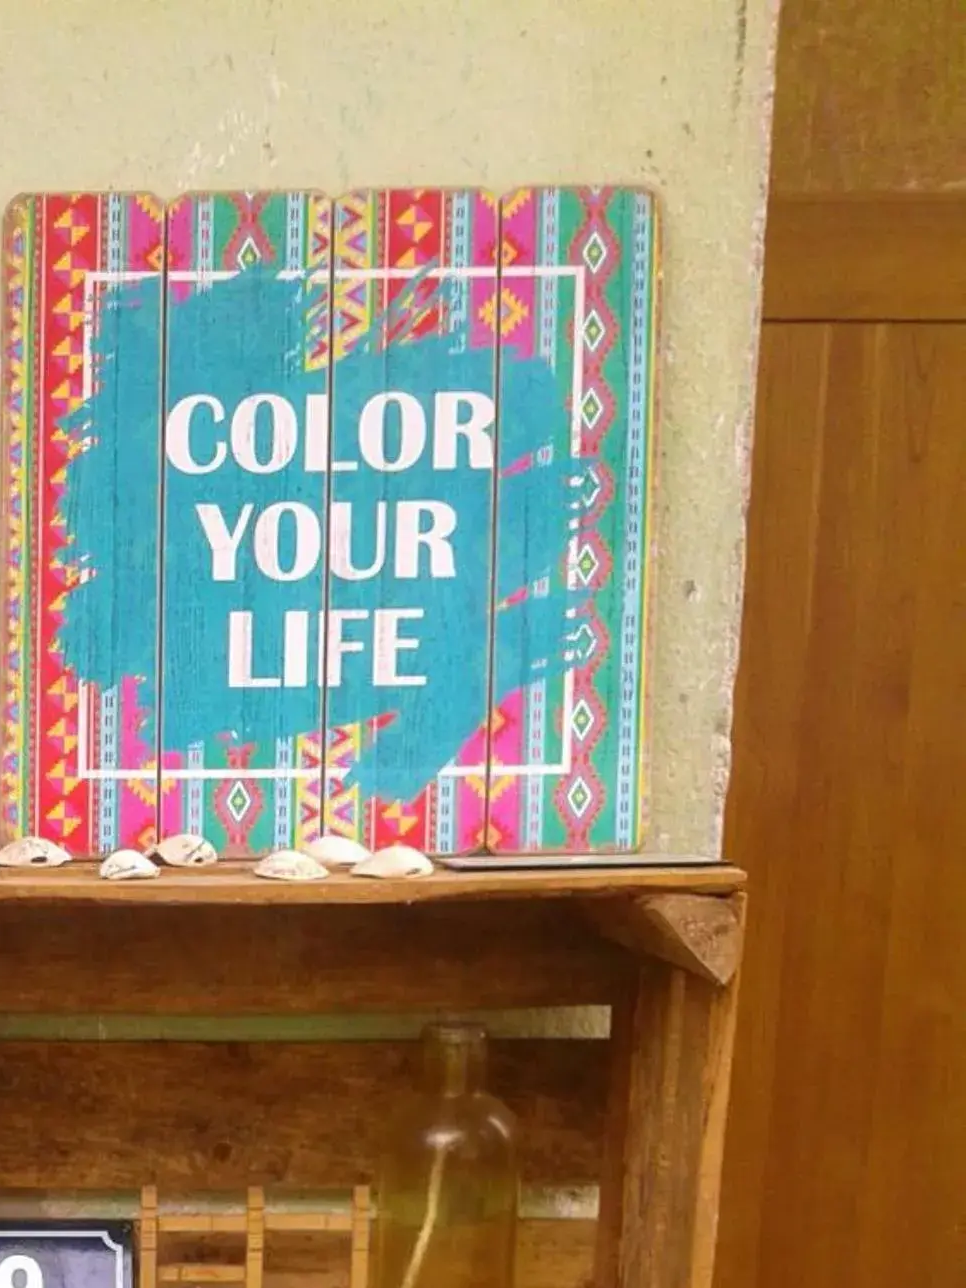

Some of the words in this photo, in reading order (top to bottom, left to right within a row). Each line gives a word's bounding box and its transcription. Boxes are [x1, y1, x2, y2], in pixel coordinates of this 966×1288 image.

[165, 391, 497, 474] COLOR
[195, 500, 458, 581] YOUR
[228, 608, 427, 688] LIFE
